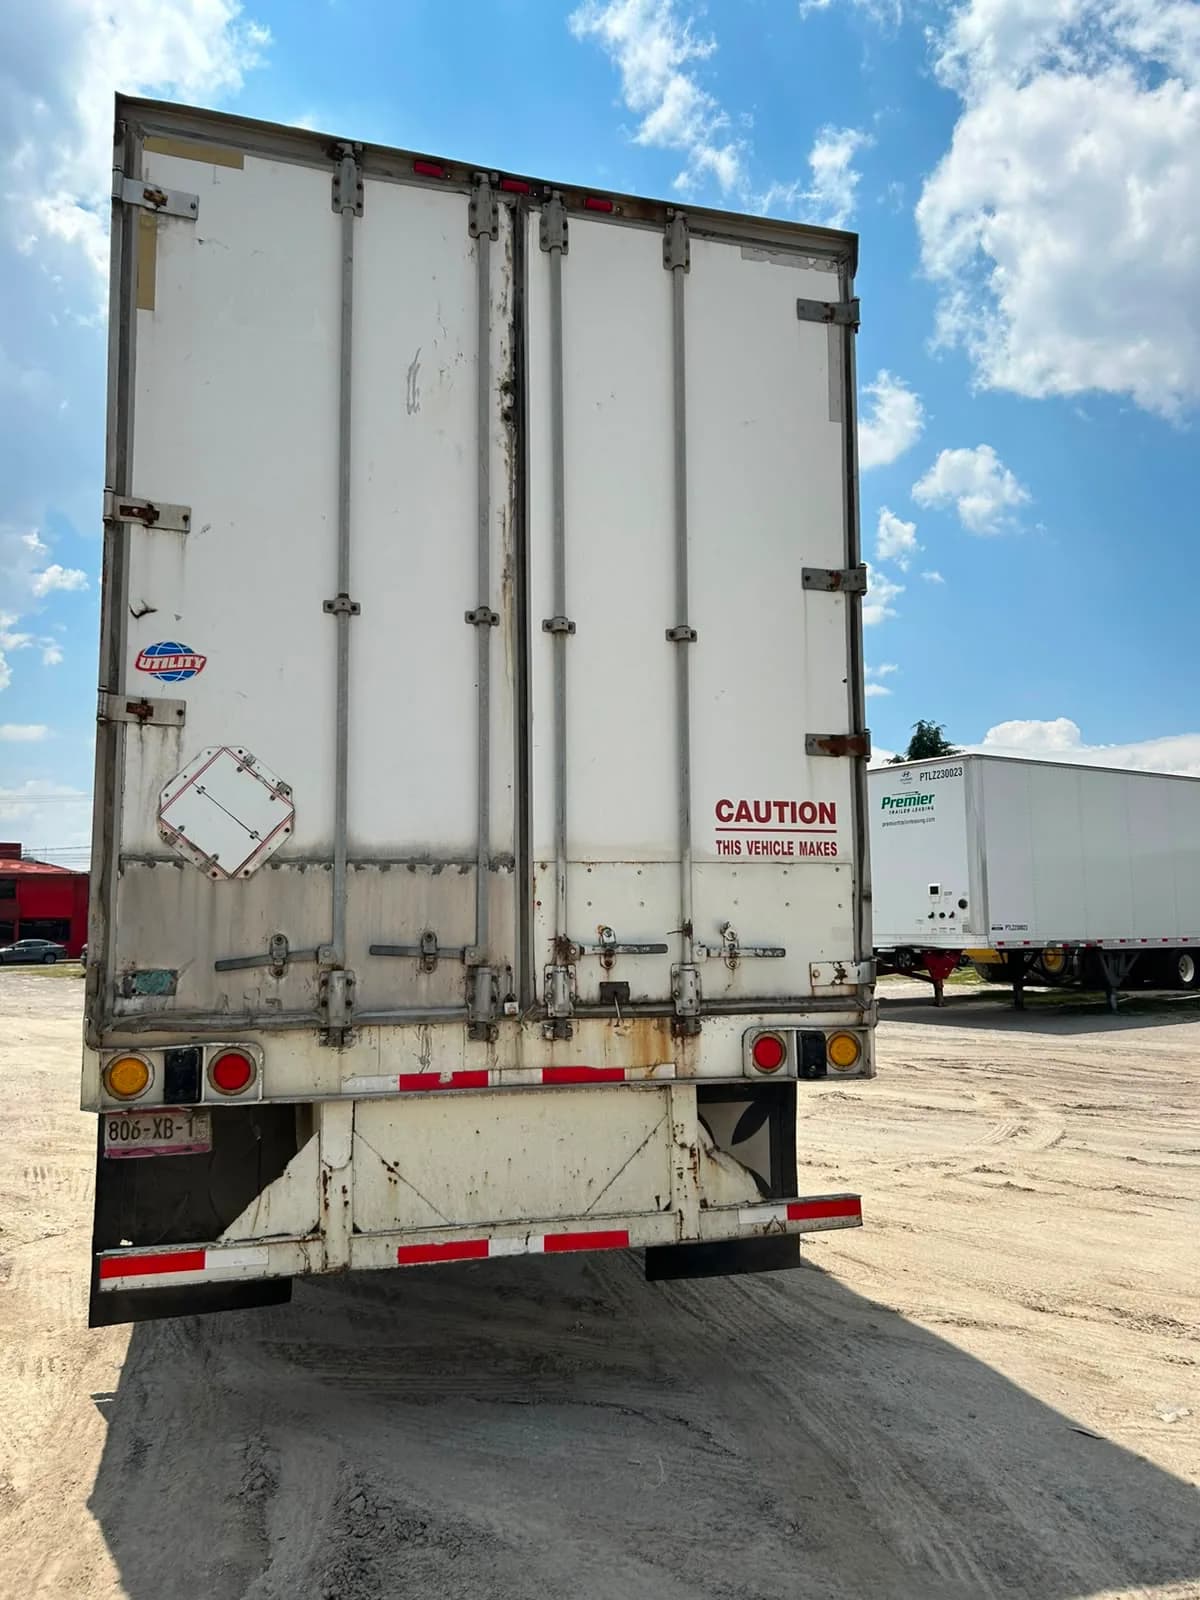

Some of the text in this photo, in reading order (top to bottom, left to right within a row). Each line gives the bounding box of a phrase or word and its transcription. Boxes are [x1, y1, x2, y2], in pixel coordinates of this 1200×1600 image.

[139, 656, 205, 669] UTILITY
[919, 766, 963, 782] PTLZ230023
[881, 794, 935, 809] Premier
[715, 798, 837, 825] CAUTION
[715, 839, 838, 857] THIS VEHICLE MAKES
[108, 1117, 194, 1142] 806-XB-1
